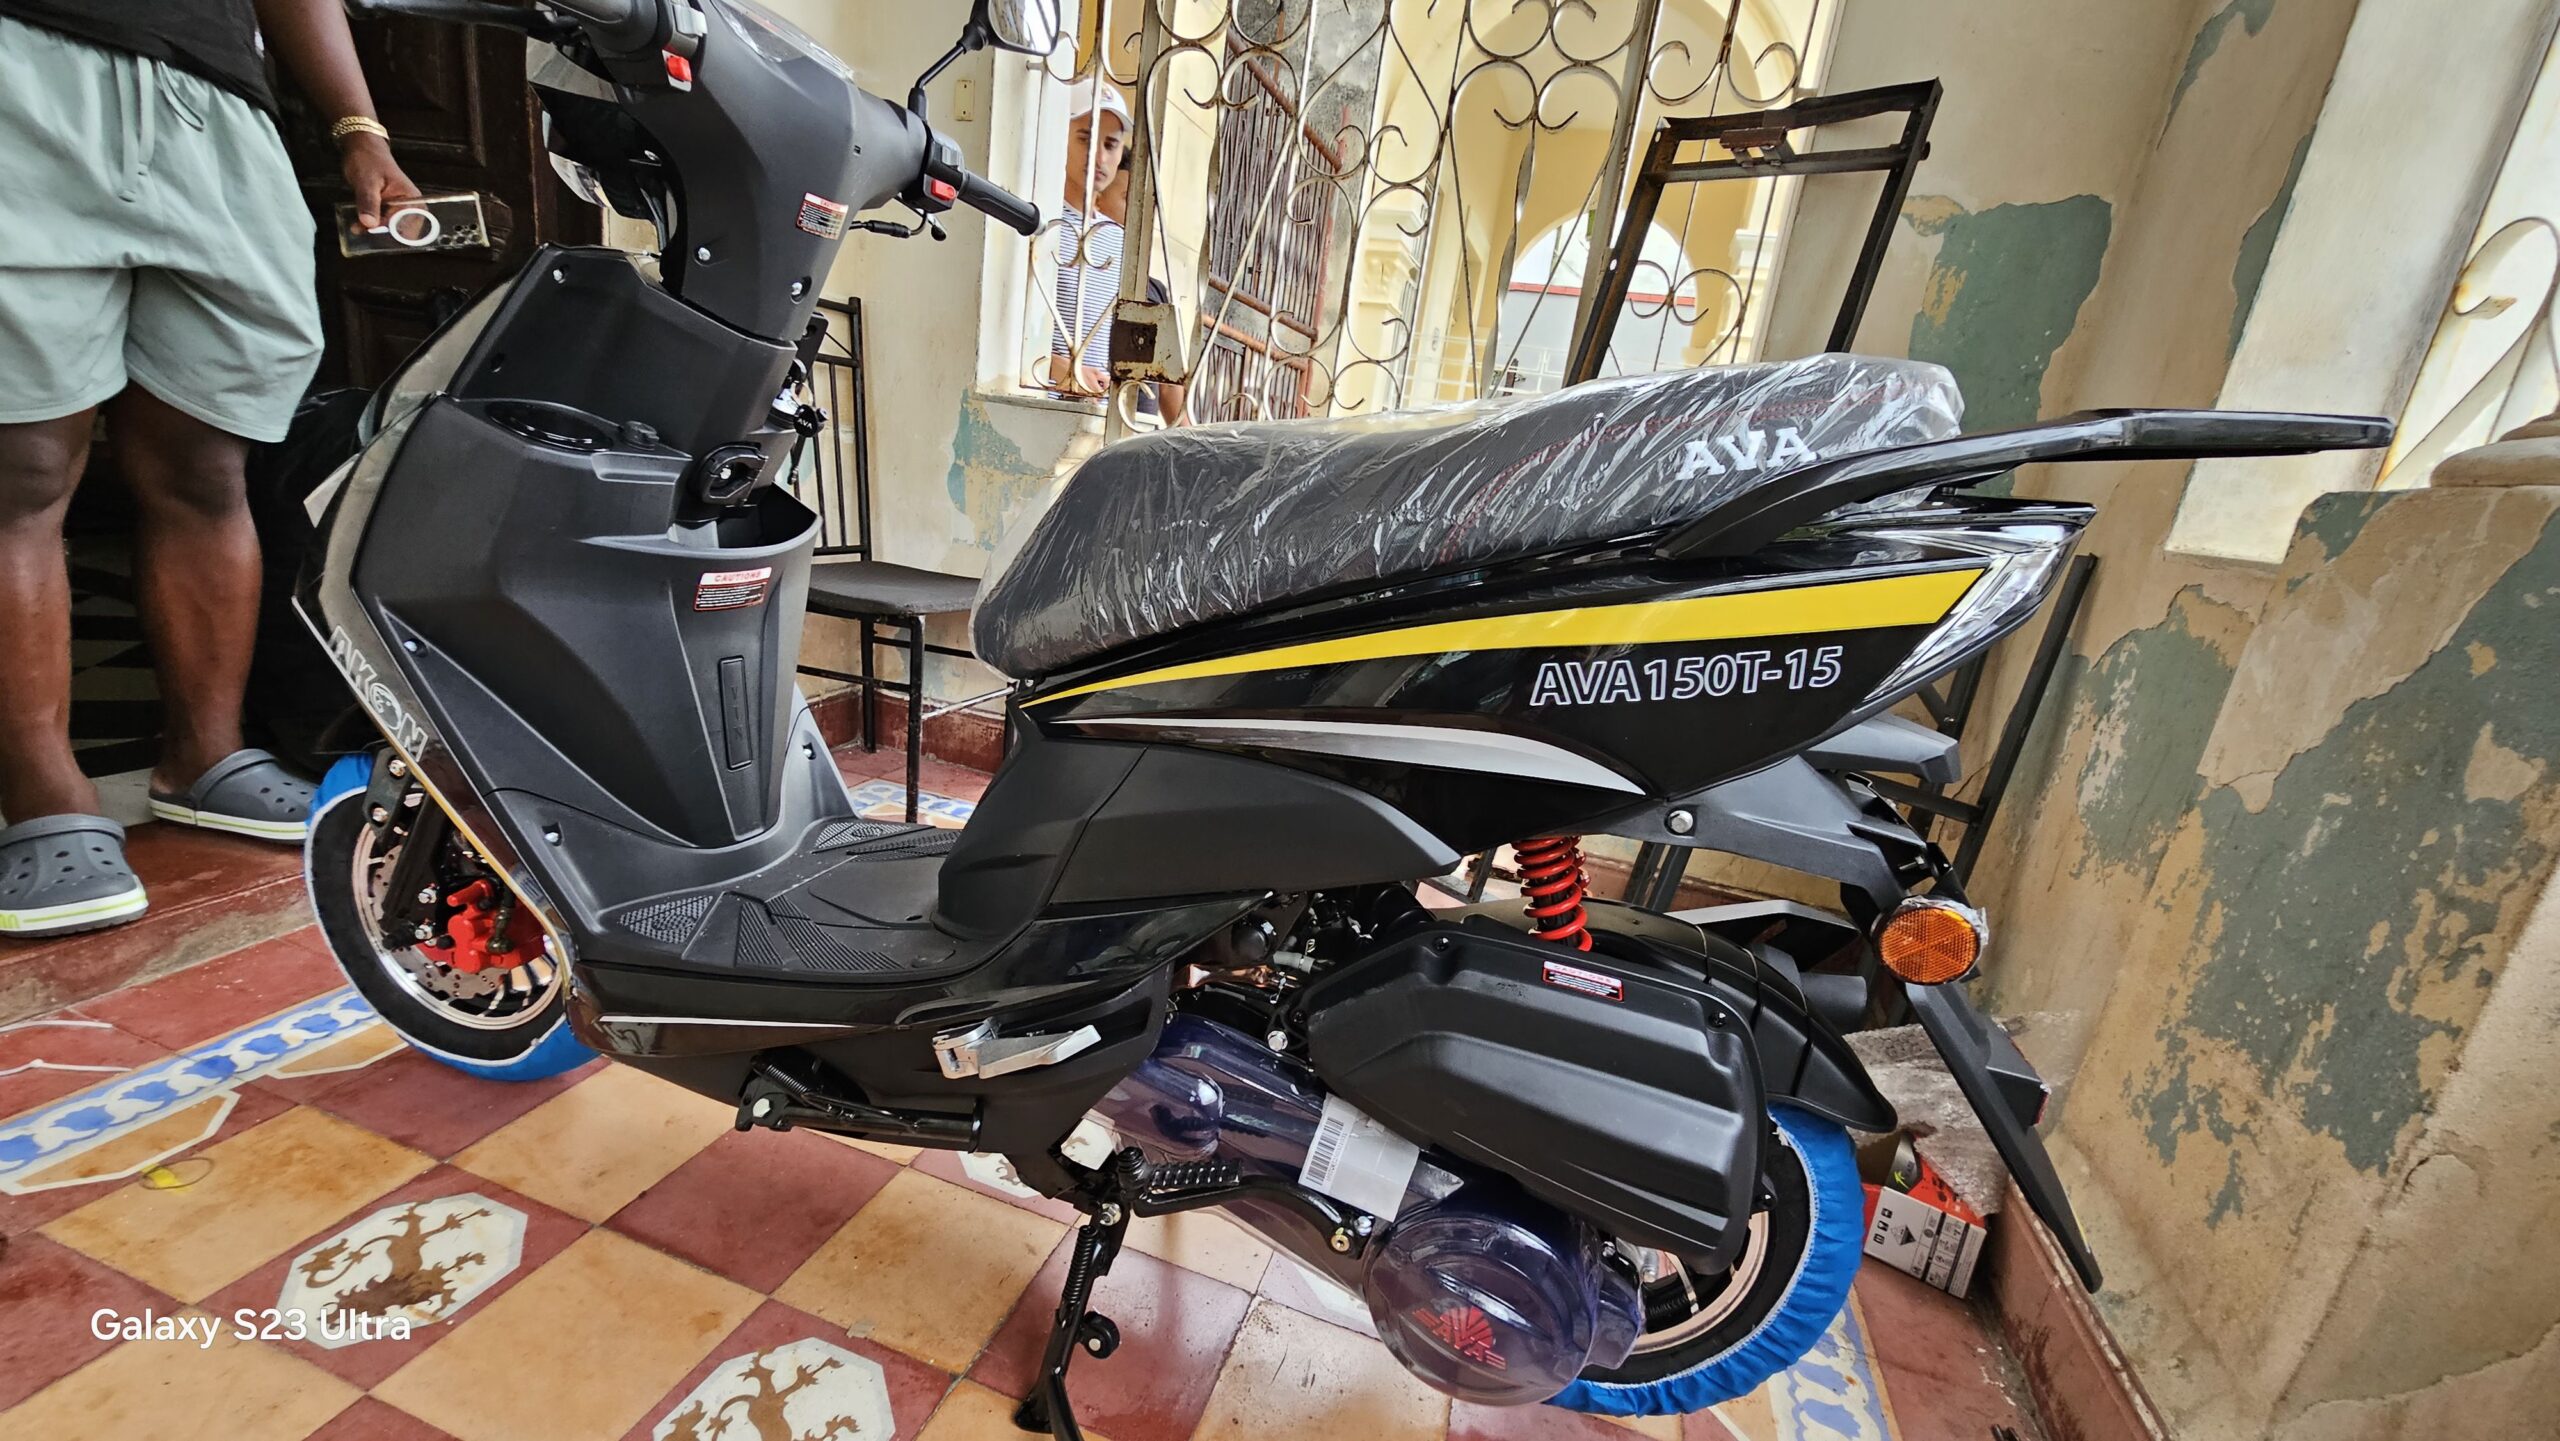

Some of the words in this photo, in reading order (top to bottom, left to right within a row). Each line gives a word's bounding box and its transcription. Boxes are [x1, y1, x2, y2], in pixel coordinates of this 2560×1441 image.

[797, 418, 813, 429] AVA
[1675, 427, 1817, 480] AVA
[1530, 645, 1843, 706] AVA150T-15
